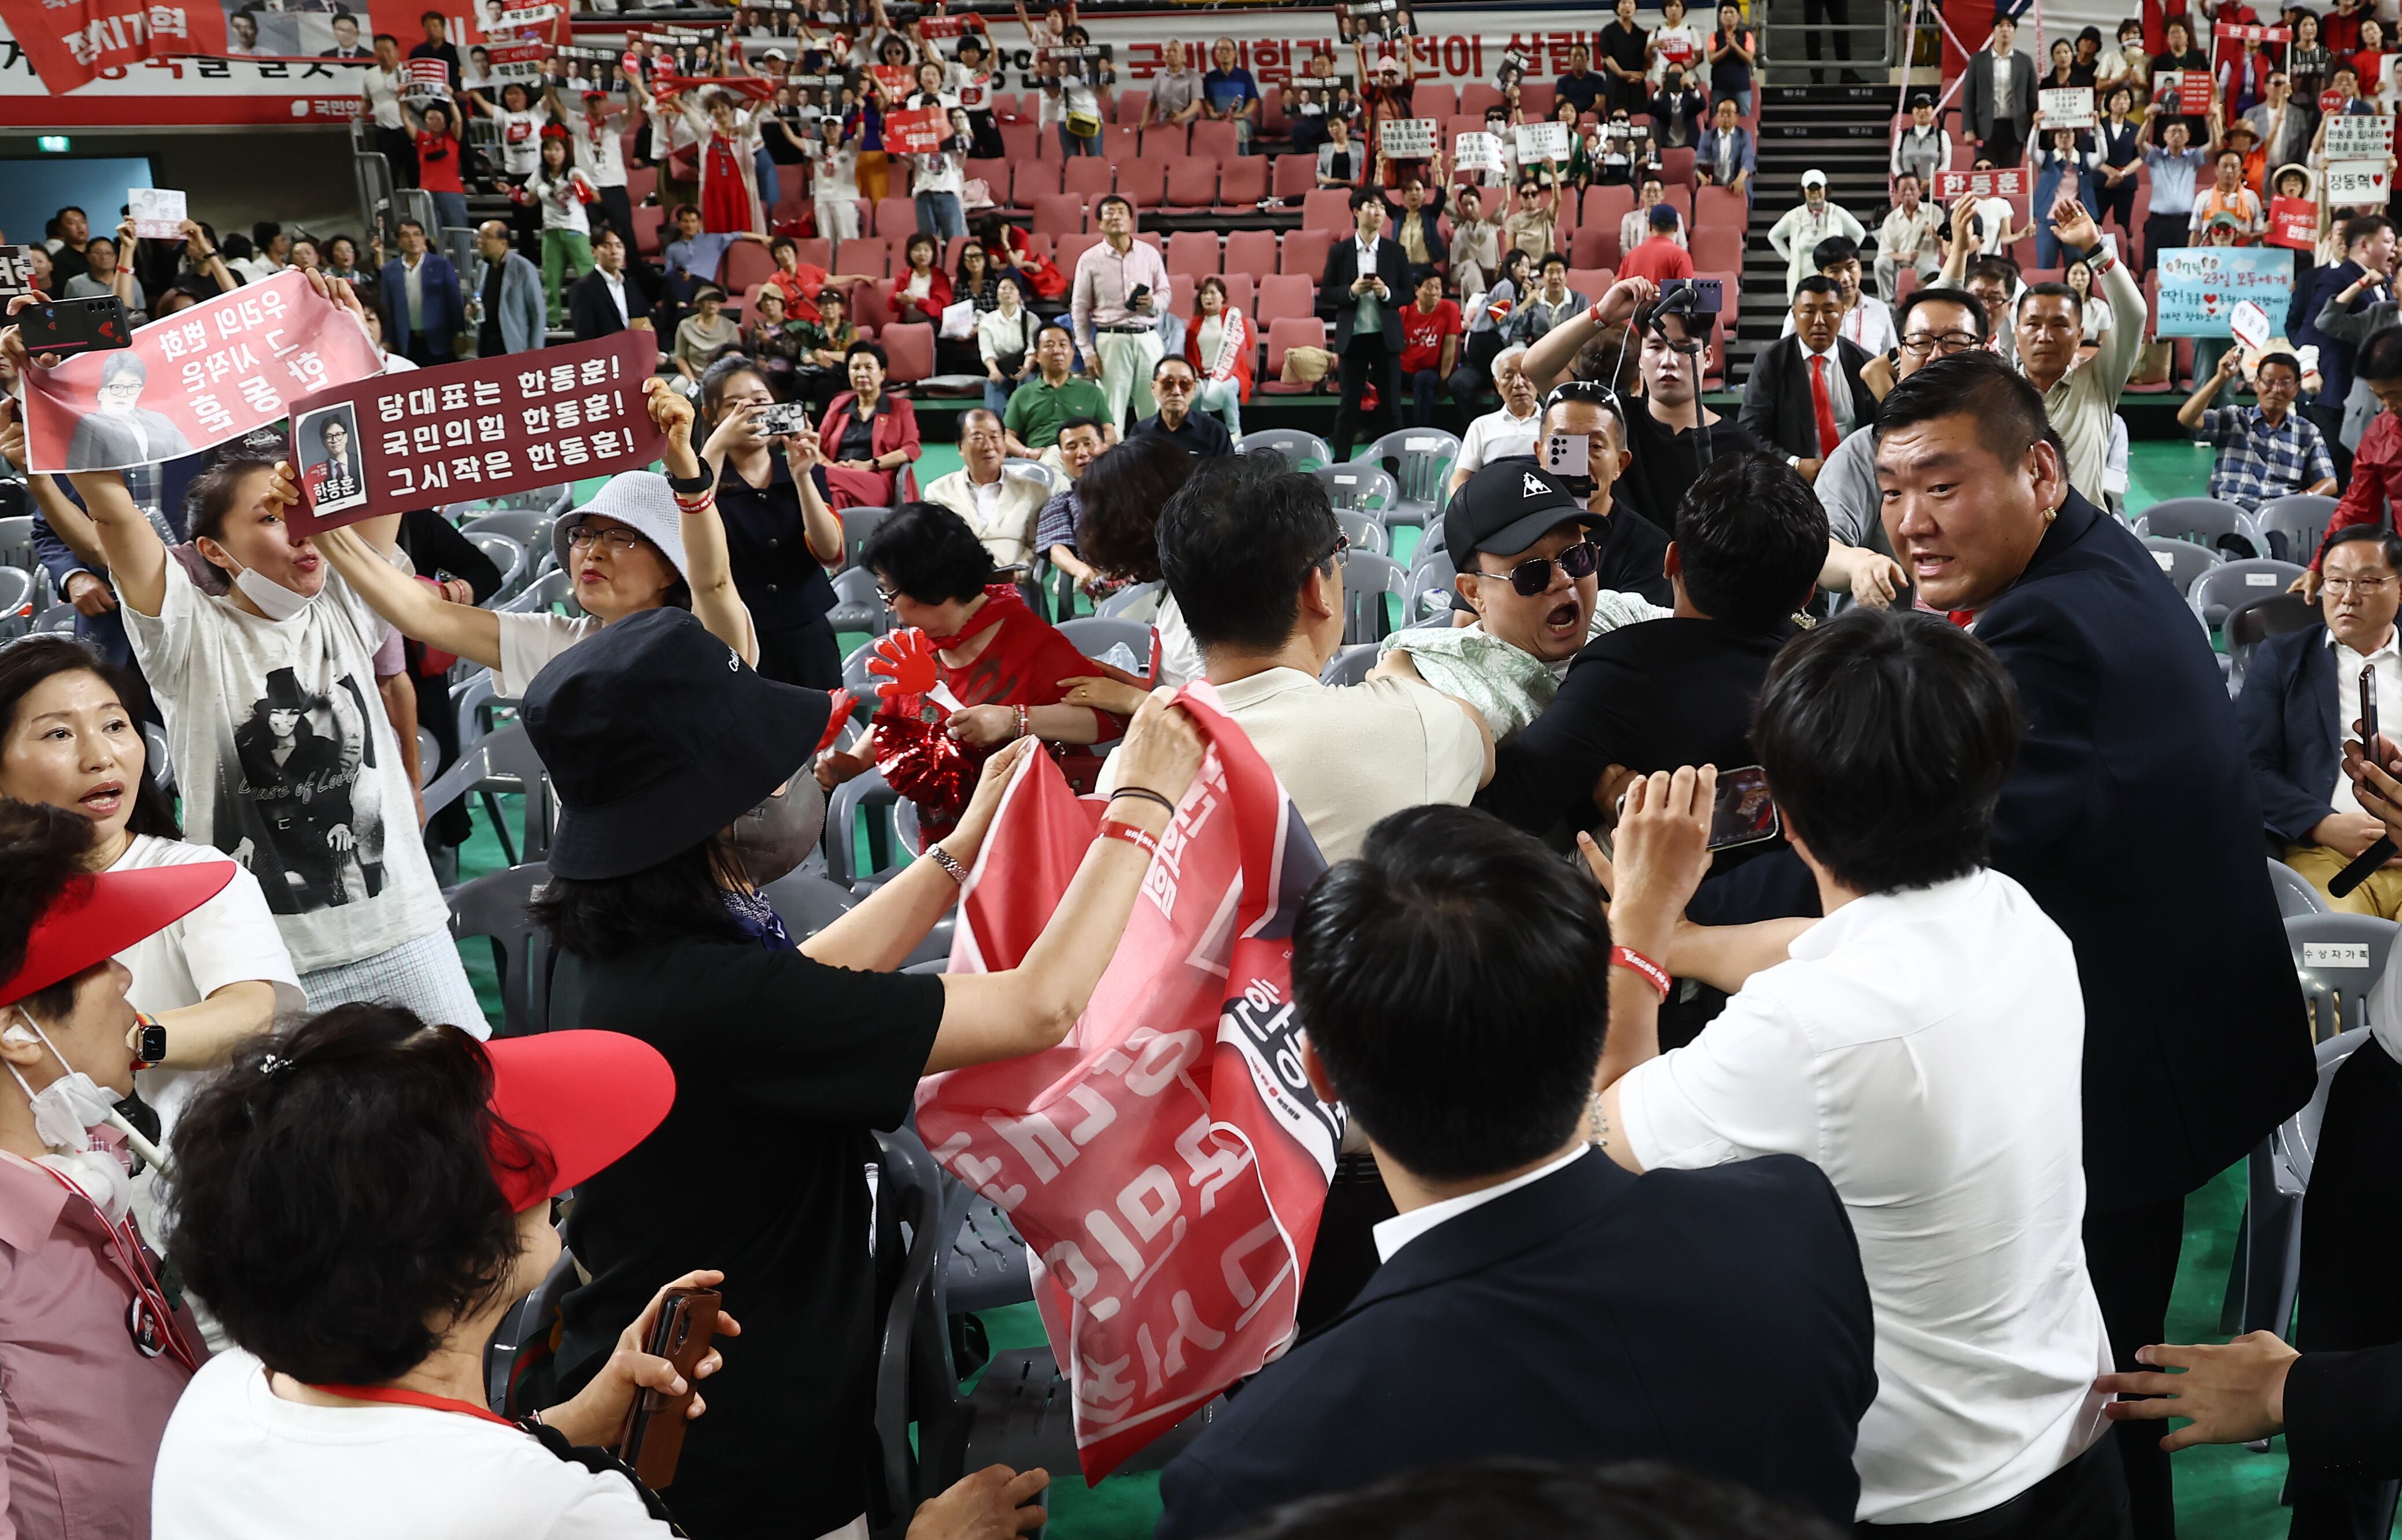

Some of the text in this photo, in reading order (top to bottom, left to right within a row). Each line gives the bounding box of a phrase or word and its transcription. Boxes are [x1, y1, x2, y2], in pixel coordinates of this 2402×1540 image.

[314, 99, 361, 116] 국민의
[1943, 172, 2019, 196] 한동훈
[2204, 271, 2230, 288] 23일
[377, 354, 620, 423] 당대표는 한동훈!
[382, 390, 626, 458] 국민의힘 한동훈!
[387, 427, 635, 498] 그시작은 한동훈!
[313, 475, 355, 503] 한동훈
[295, 770, 315, 805] of
[317, 767, 355, 797] Love
